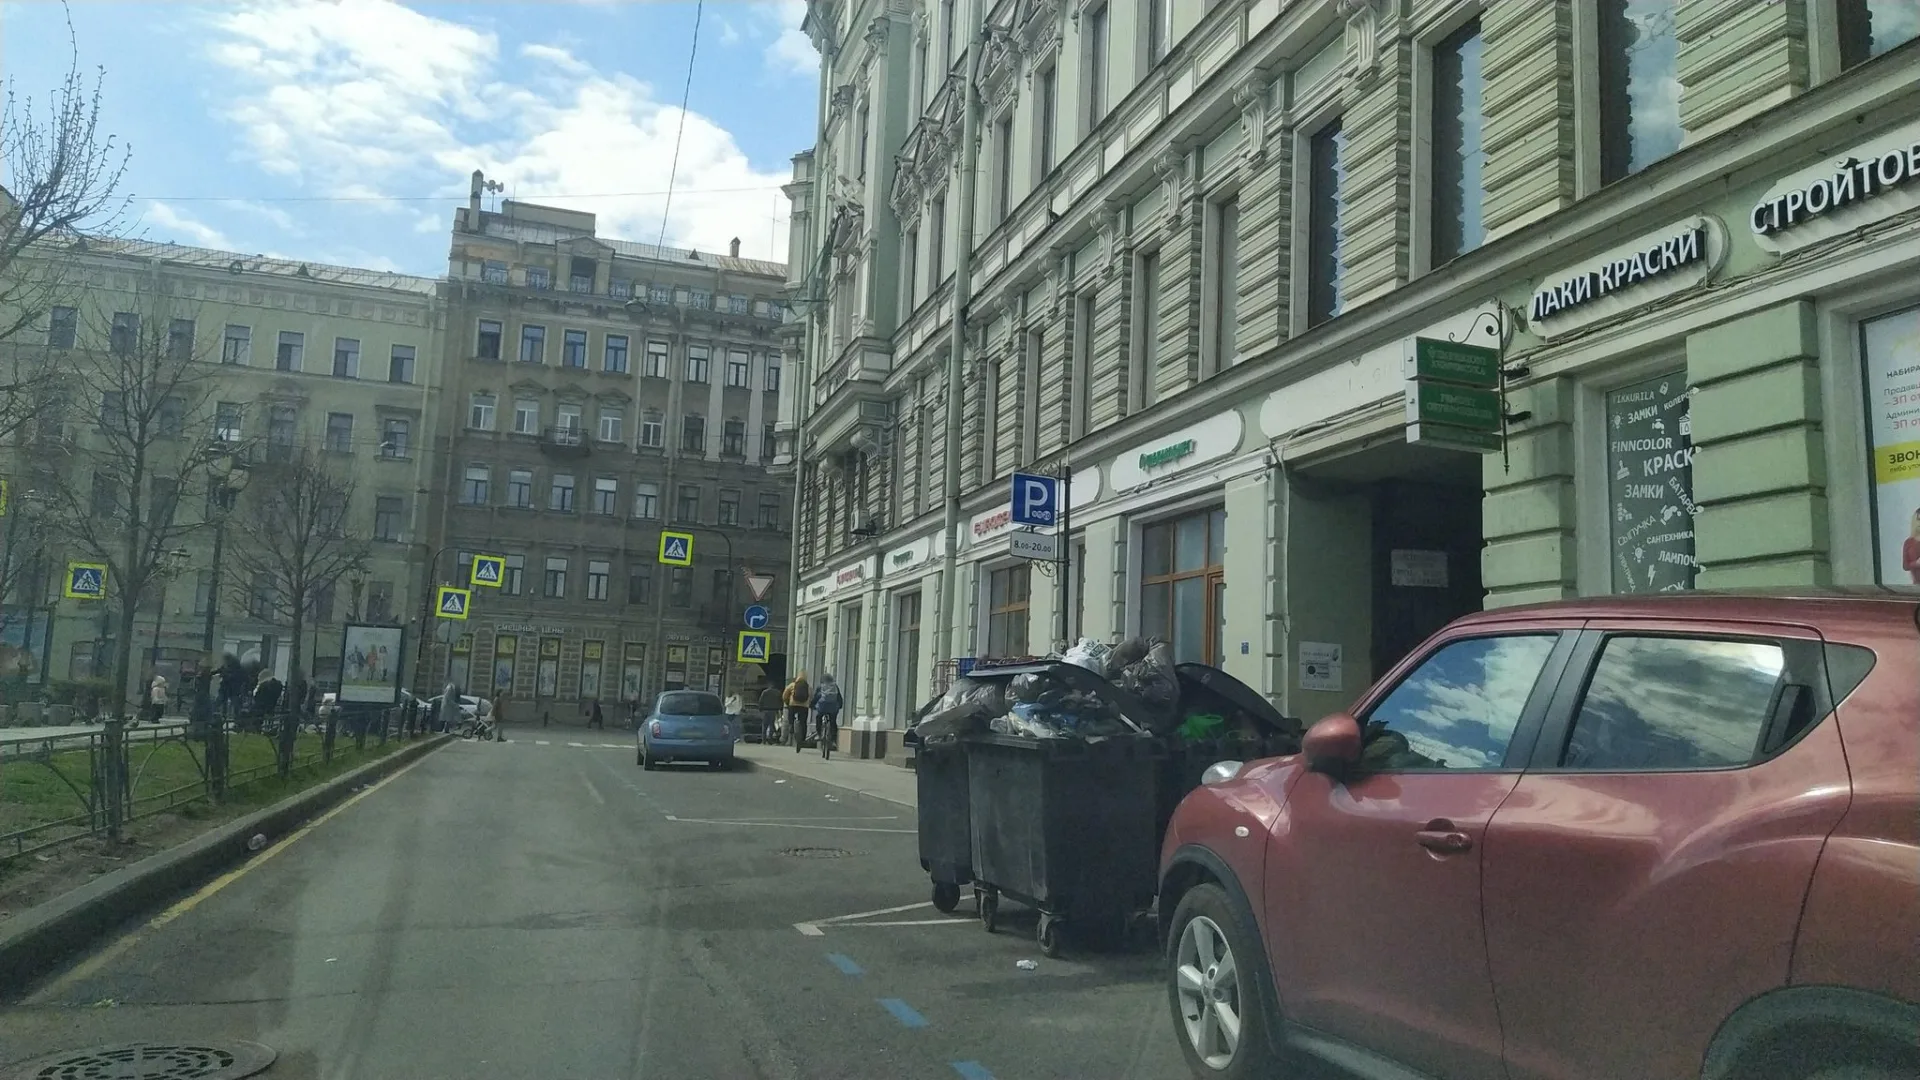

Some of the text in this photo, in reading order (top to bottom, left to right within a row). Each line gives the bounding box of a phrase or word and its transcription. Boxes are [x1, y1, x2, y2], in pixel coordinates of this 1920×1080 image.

[1532, 229, 1698, 318] ЛАКИ КРАСКИ
[1628, 404, 1658, 424] ЗАМКИ
[1611, 437, 1673, 453] FINNCOLOR
[1643, 446, 1695, 477] КРАСК
[1024, 480, 1048, 518] P
[1624, 484, 1664, 499] ЗАМКИ
[1617, 515, 1656, 546] СЫПУЧКА
[1647, 530, 1693, 544] САНТЕХНИКА
